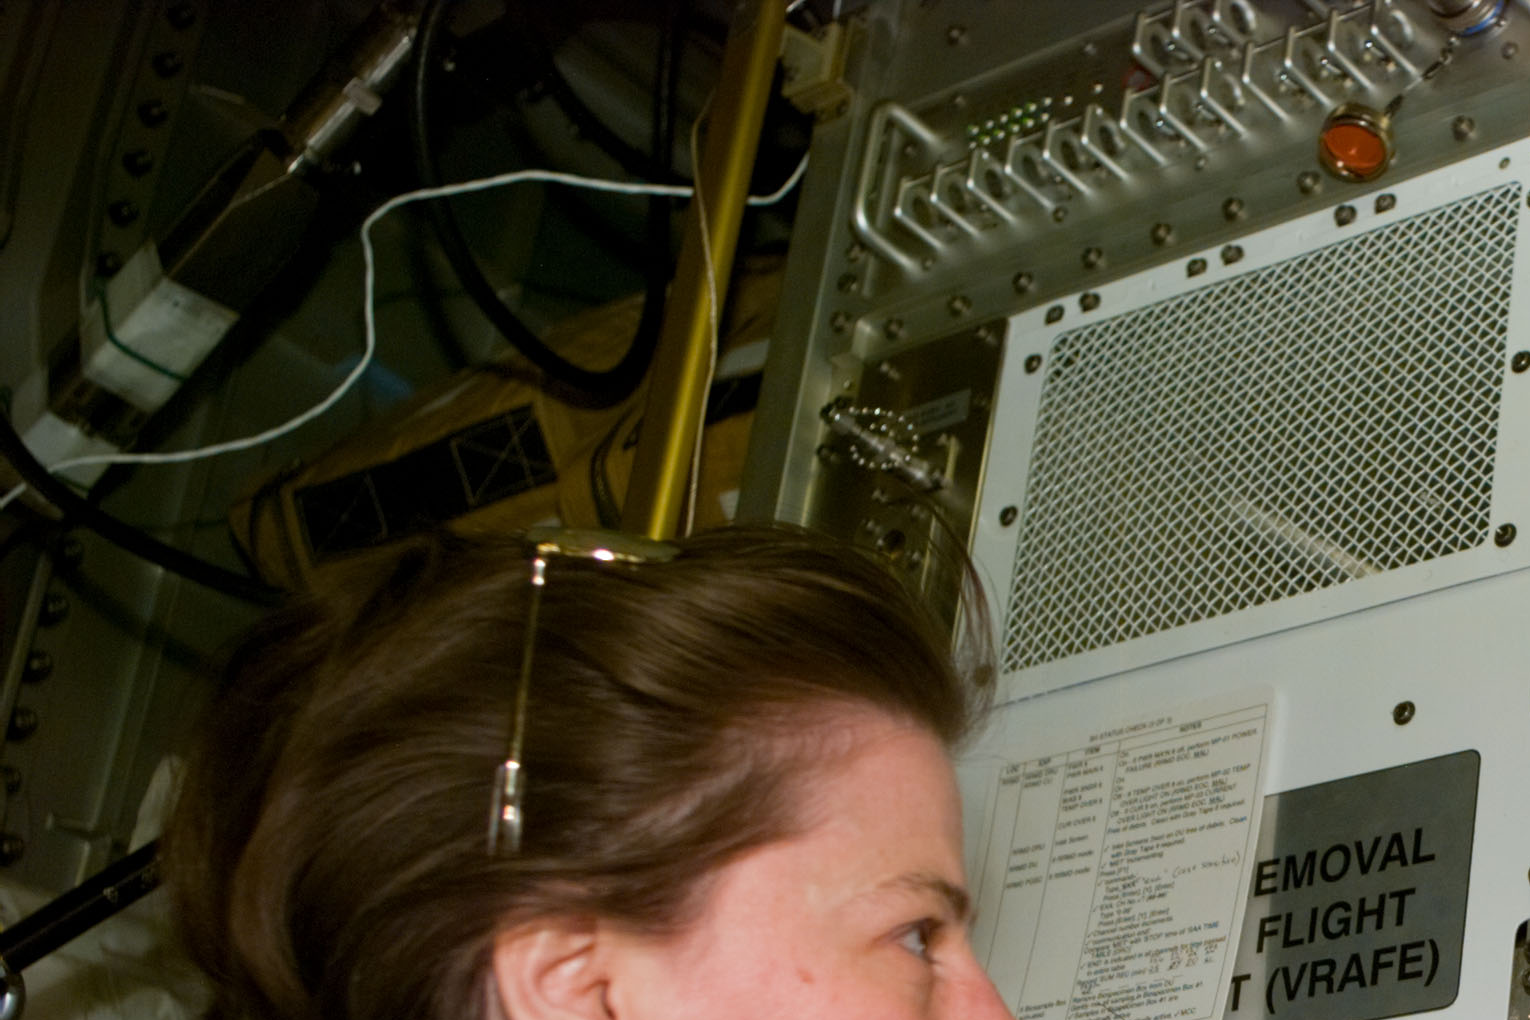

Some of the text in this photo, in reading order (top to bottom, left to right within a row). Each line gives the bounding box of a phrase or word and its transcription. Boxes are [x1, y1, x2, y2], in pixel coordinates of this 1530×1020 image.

[1256, 888, 1416, 953] FLIGHT
[1231, 974, 1251, 1012] T
[1266, 939, 1439, 1014] (VRAFE)
